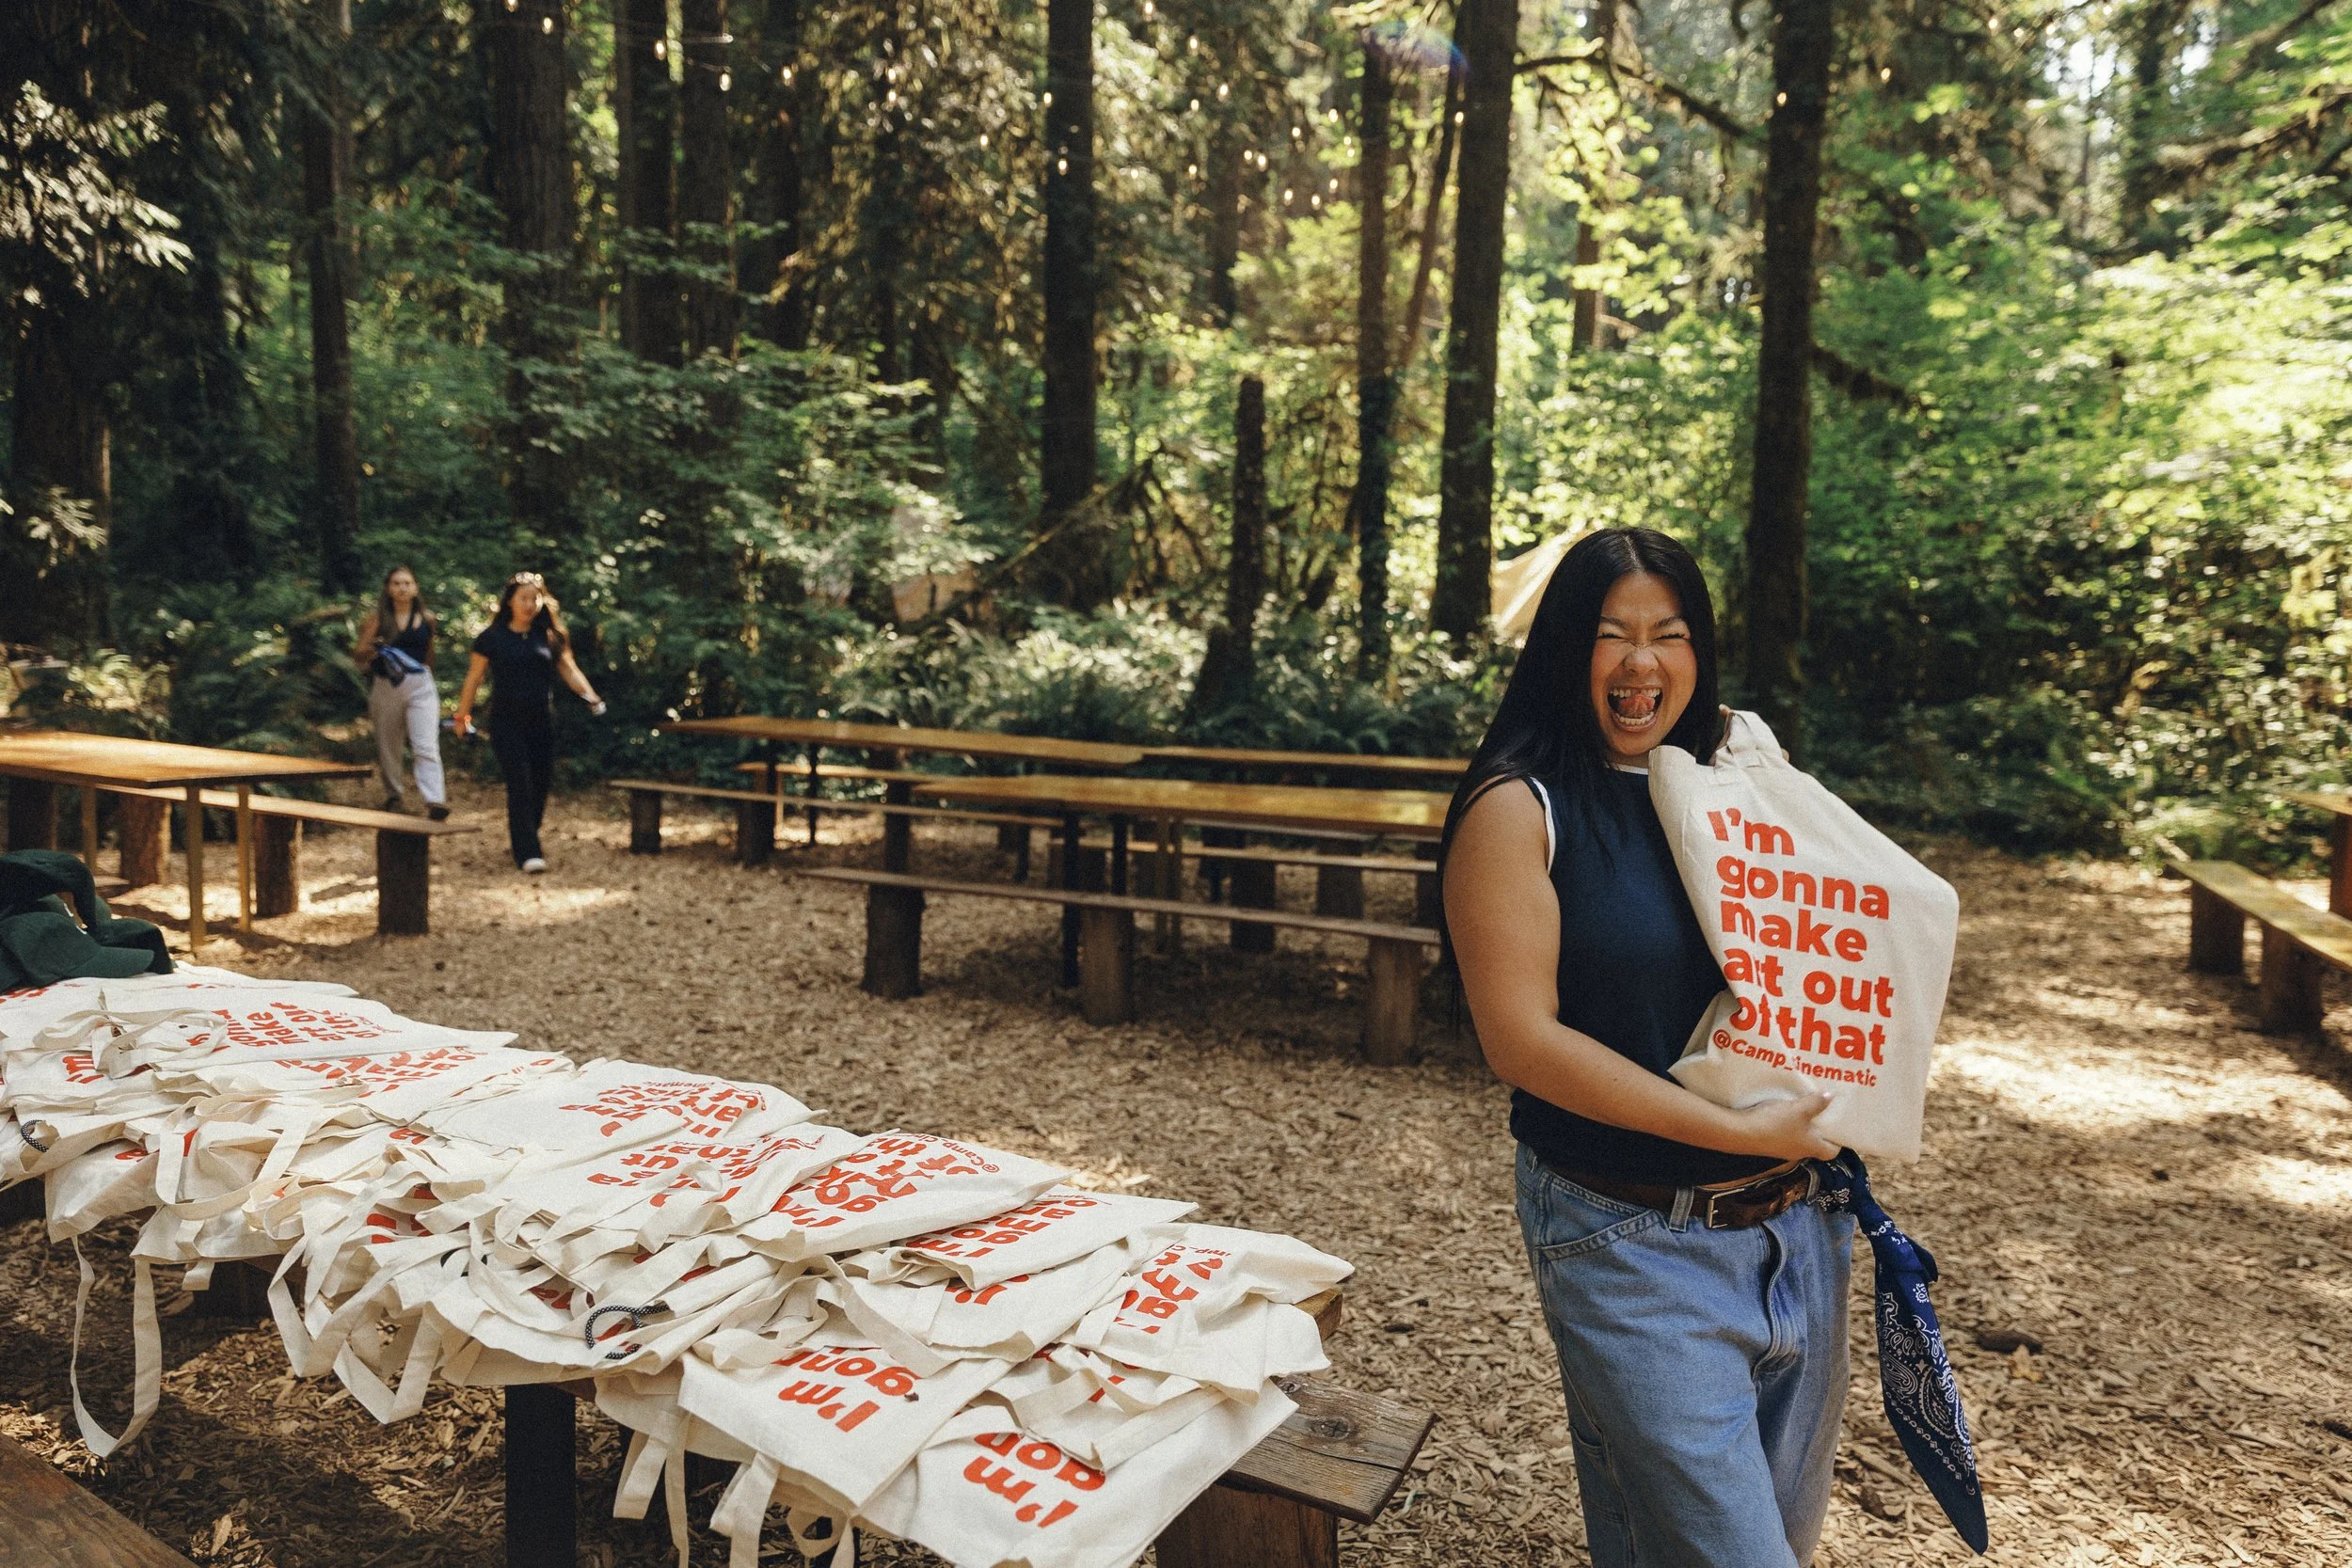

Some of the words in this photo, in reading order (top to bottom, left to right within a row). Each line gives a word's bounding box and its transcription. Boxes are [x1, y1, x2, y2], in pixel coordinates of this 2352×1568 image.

[1707, 807, 1795, 857] I'm
[1715, 855, 1891, 921] gonna
[1720, 899, 1867, 962] make
[1803, 970, 1894, 1019] out
[1775, 1006, 1885, 1065] that
[777, 1381, 881, 1433] I'm
[962, 1455, 1079, 1529] I'm
